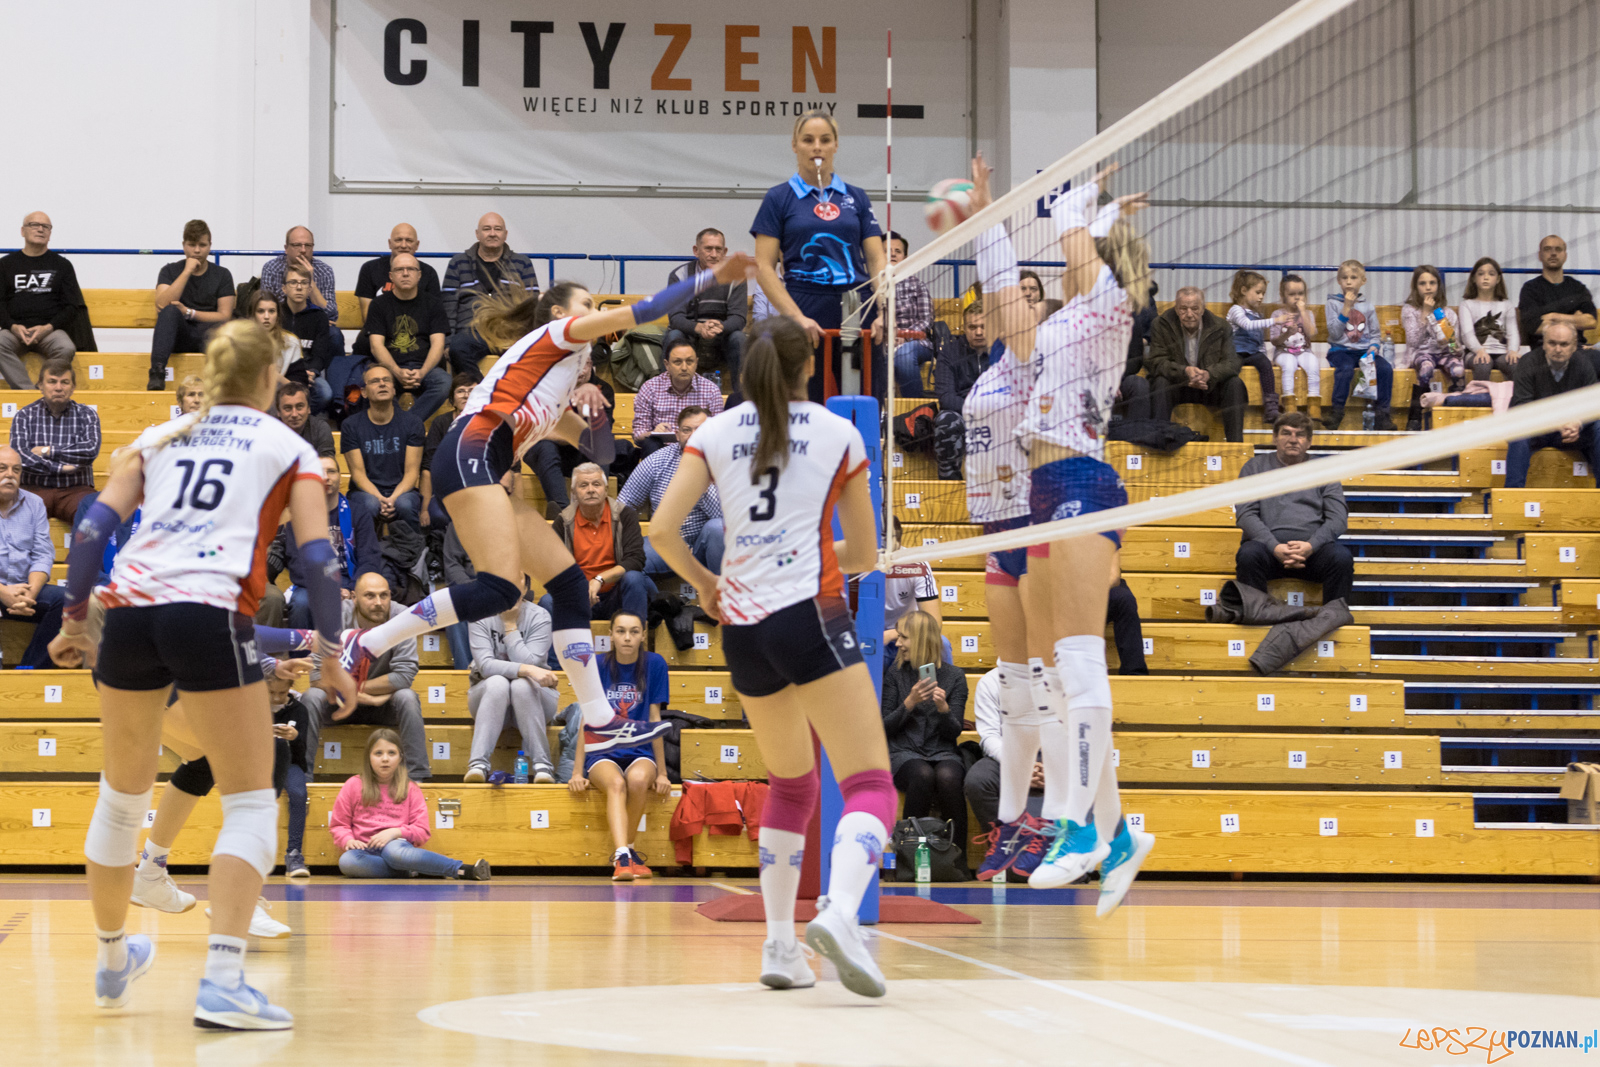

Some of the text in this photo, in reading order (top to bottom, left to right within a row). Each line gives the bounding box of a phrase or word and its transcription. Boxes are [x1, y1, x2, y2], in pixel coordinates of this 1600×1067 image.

[383, 18, 837, 93] CITYZEN
[523, 96, 837, 117] WIĘCEJ NIŻ KLUB SPORTOWY
[199, 414, 262, 427] OBIASZ
[468, 458, 479, 474] 7
[171, 458, 234, 511] 16
[750, 466, 780, 522] 3
[908, 495, 917, 504] 13
[945, 588, 954, 597] 13
[1204, 592, 1213, 600] 10
[696, 636, 705, 644] 16
[839, 631, 856, 650] 3
[965, 638, 974, 647] 13
[1232, 642, 1241, 651] 10
[709, 690, 718, 698] 16
[1262, 697, 1271, 705] 10
[725, 748, 734, 757] 16
[1196, 754, 1206, 762] 11
[1293, 754, 1302, 762] 10
[1131, 816, 1140, 825] 12
[1225, 818, 1235, 826] 11
[1324, 821, 1334, 830] 10
